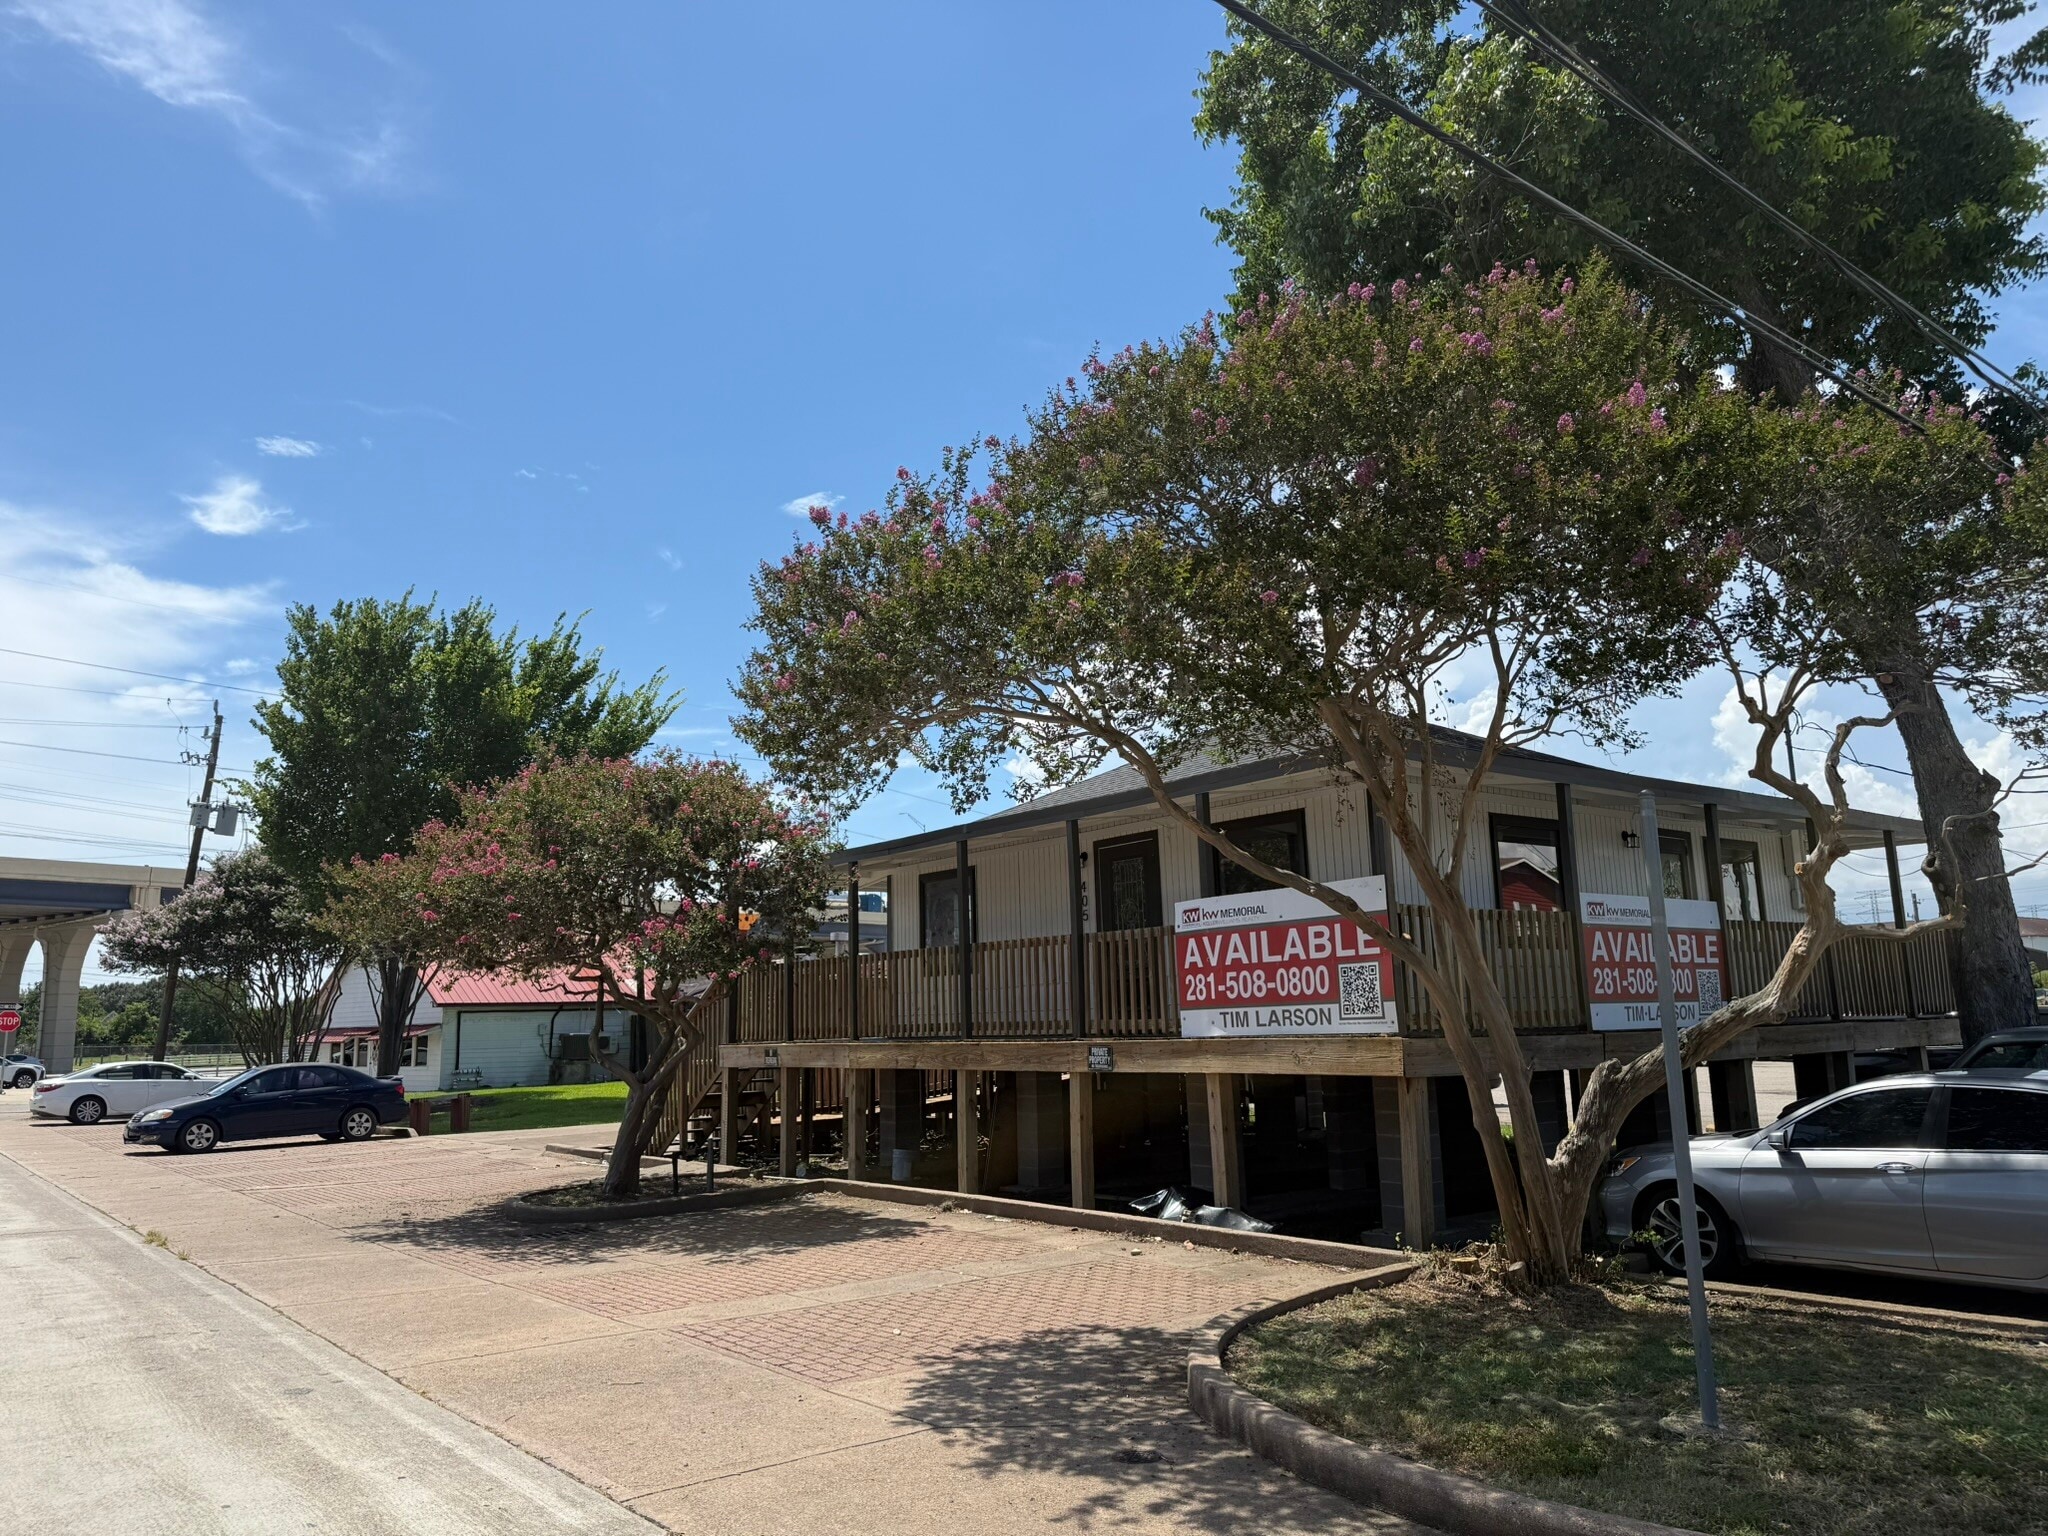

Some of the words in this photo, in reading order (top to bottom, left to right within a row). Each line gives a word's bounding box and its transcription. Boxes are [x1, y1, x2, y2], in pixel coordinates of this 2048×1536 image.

[1183, 910, 1200, 923] KW
[1220, 905, 1267, 918] MEMORIAL
[1588, 904, 1604, 916] KW
[1620, 907, 1651, 918] MEMORIAL
[1184, 923, 1380, 968] AVAILABLE
[1185, 965, 1329, 1000] 281-508-0800
[1594, 967, 1692, 994] 281-508-800
[1219, 1011, 1249, 1028] TIM
[1256, 1007, 1332, 1027] LARSON
[1624, 1006, 1645, 1022] TIM
[1648, 1004, 1695, 1021] LASON
[1089, 1056, 1110, 1064] PROPERTY
